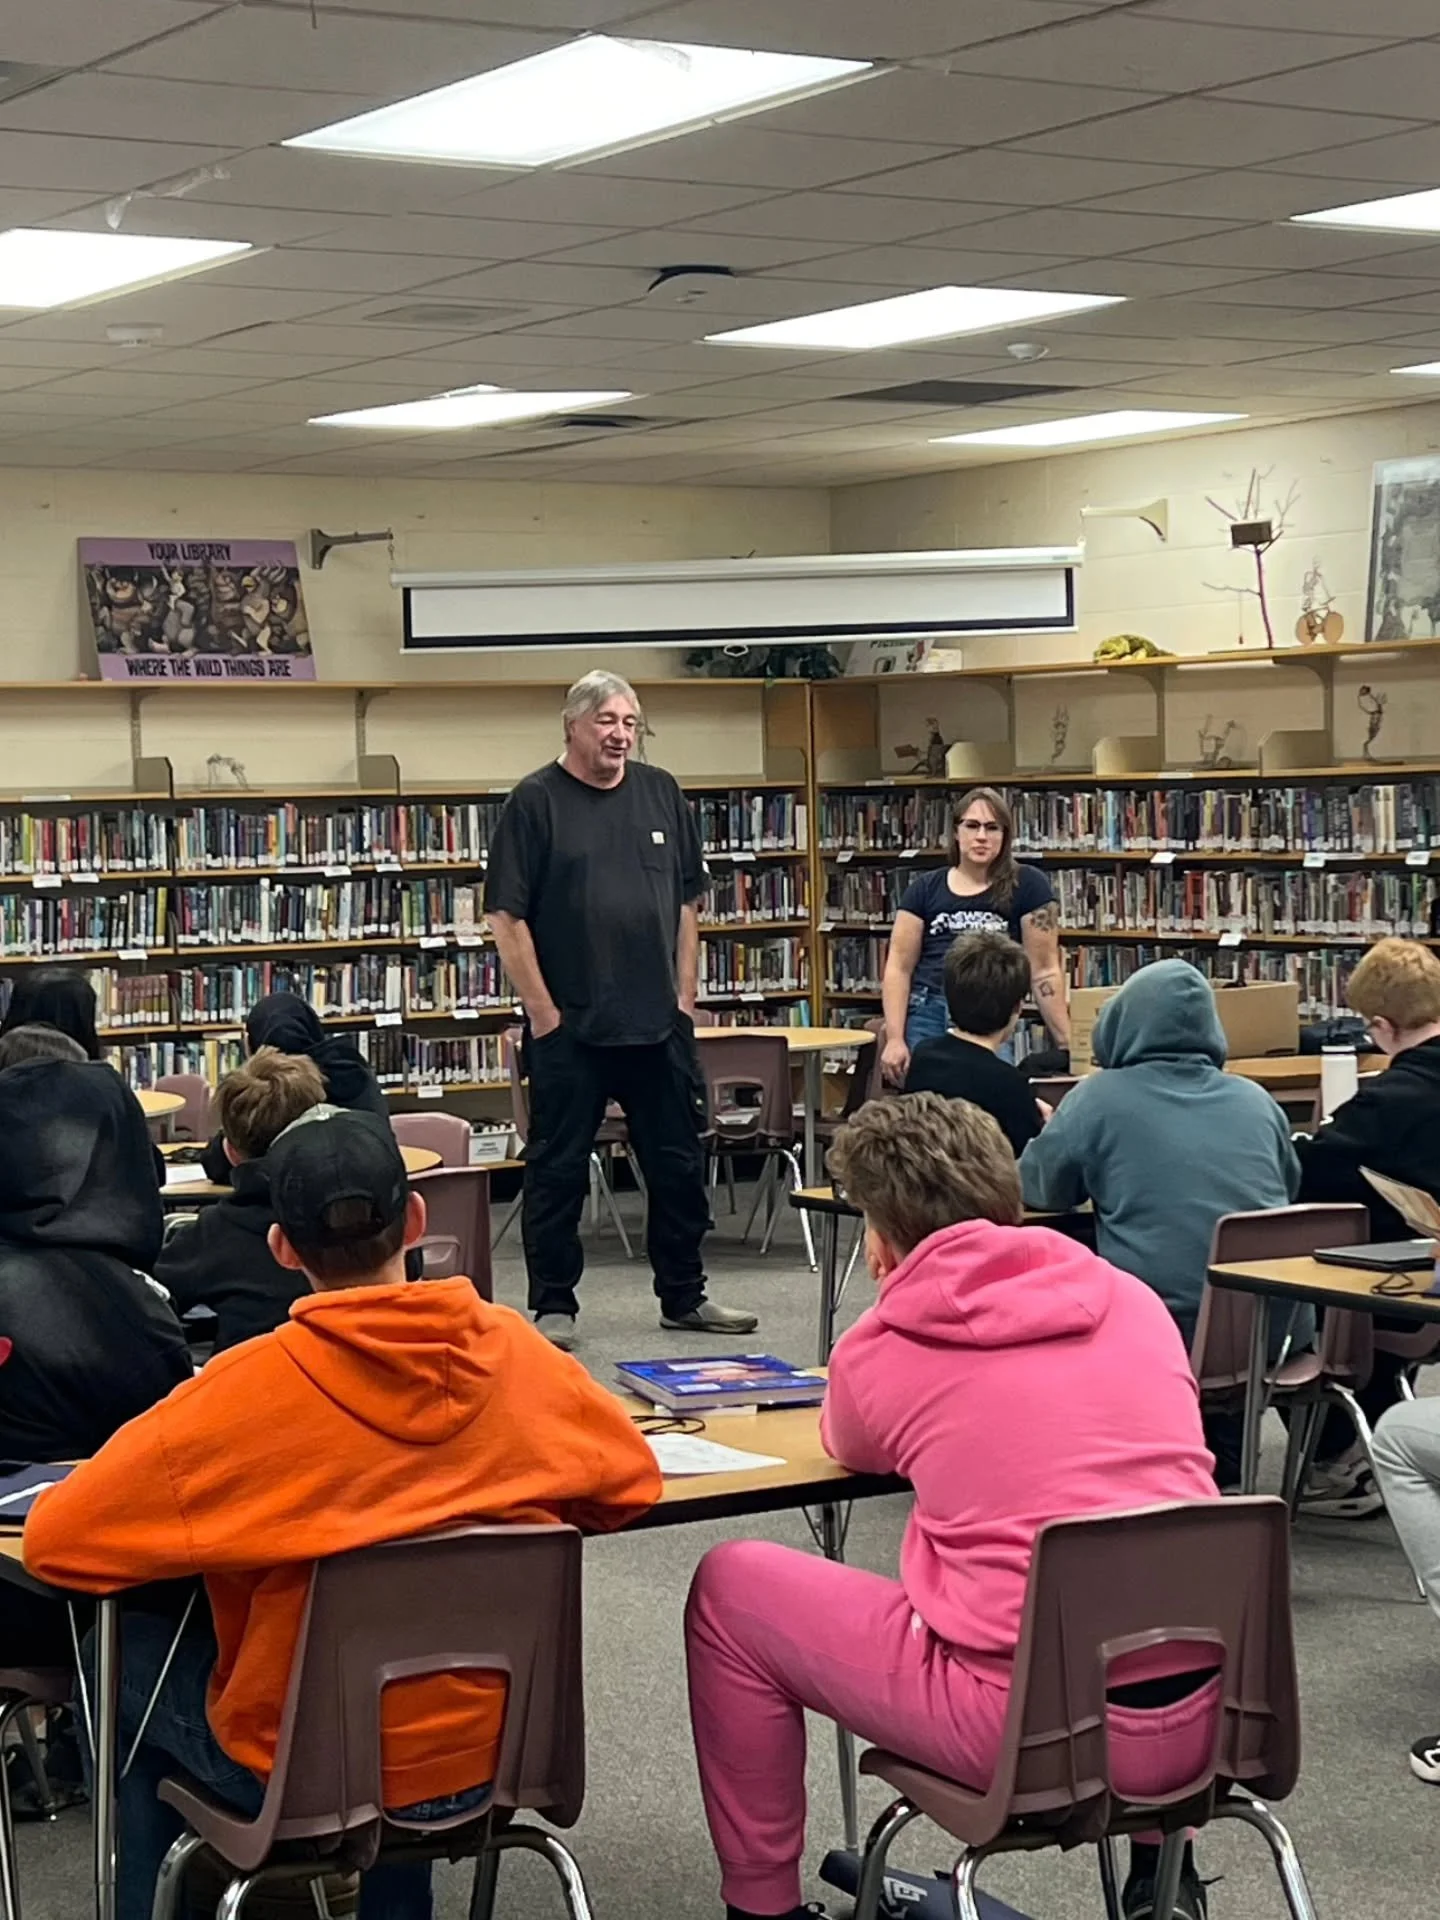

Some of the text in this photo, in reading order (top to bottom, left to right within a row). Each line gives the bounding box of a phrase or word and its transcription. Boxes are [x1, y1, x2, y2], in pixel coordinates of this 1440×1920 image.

[147, 543, 231, 560] YOUR LIBRARY
[125, 658, 291, 676] WHERE THE WILD THINGS ARE
